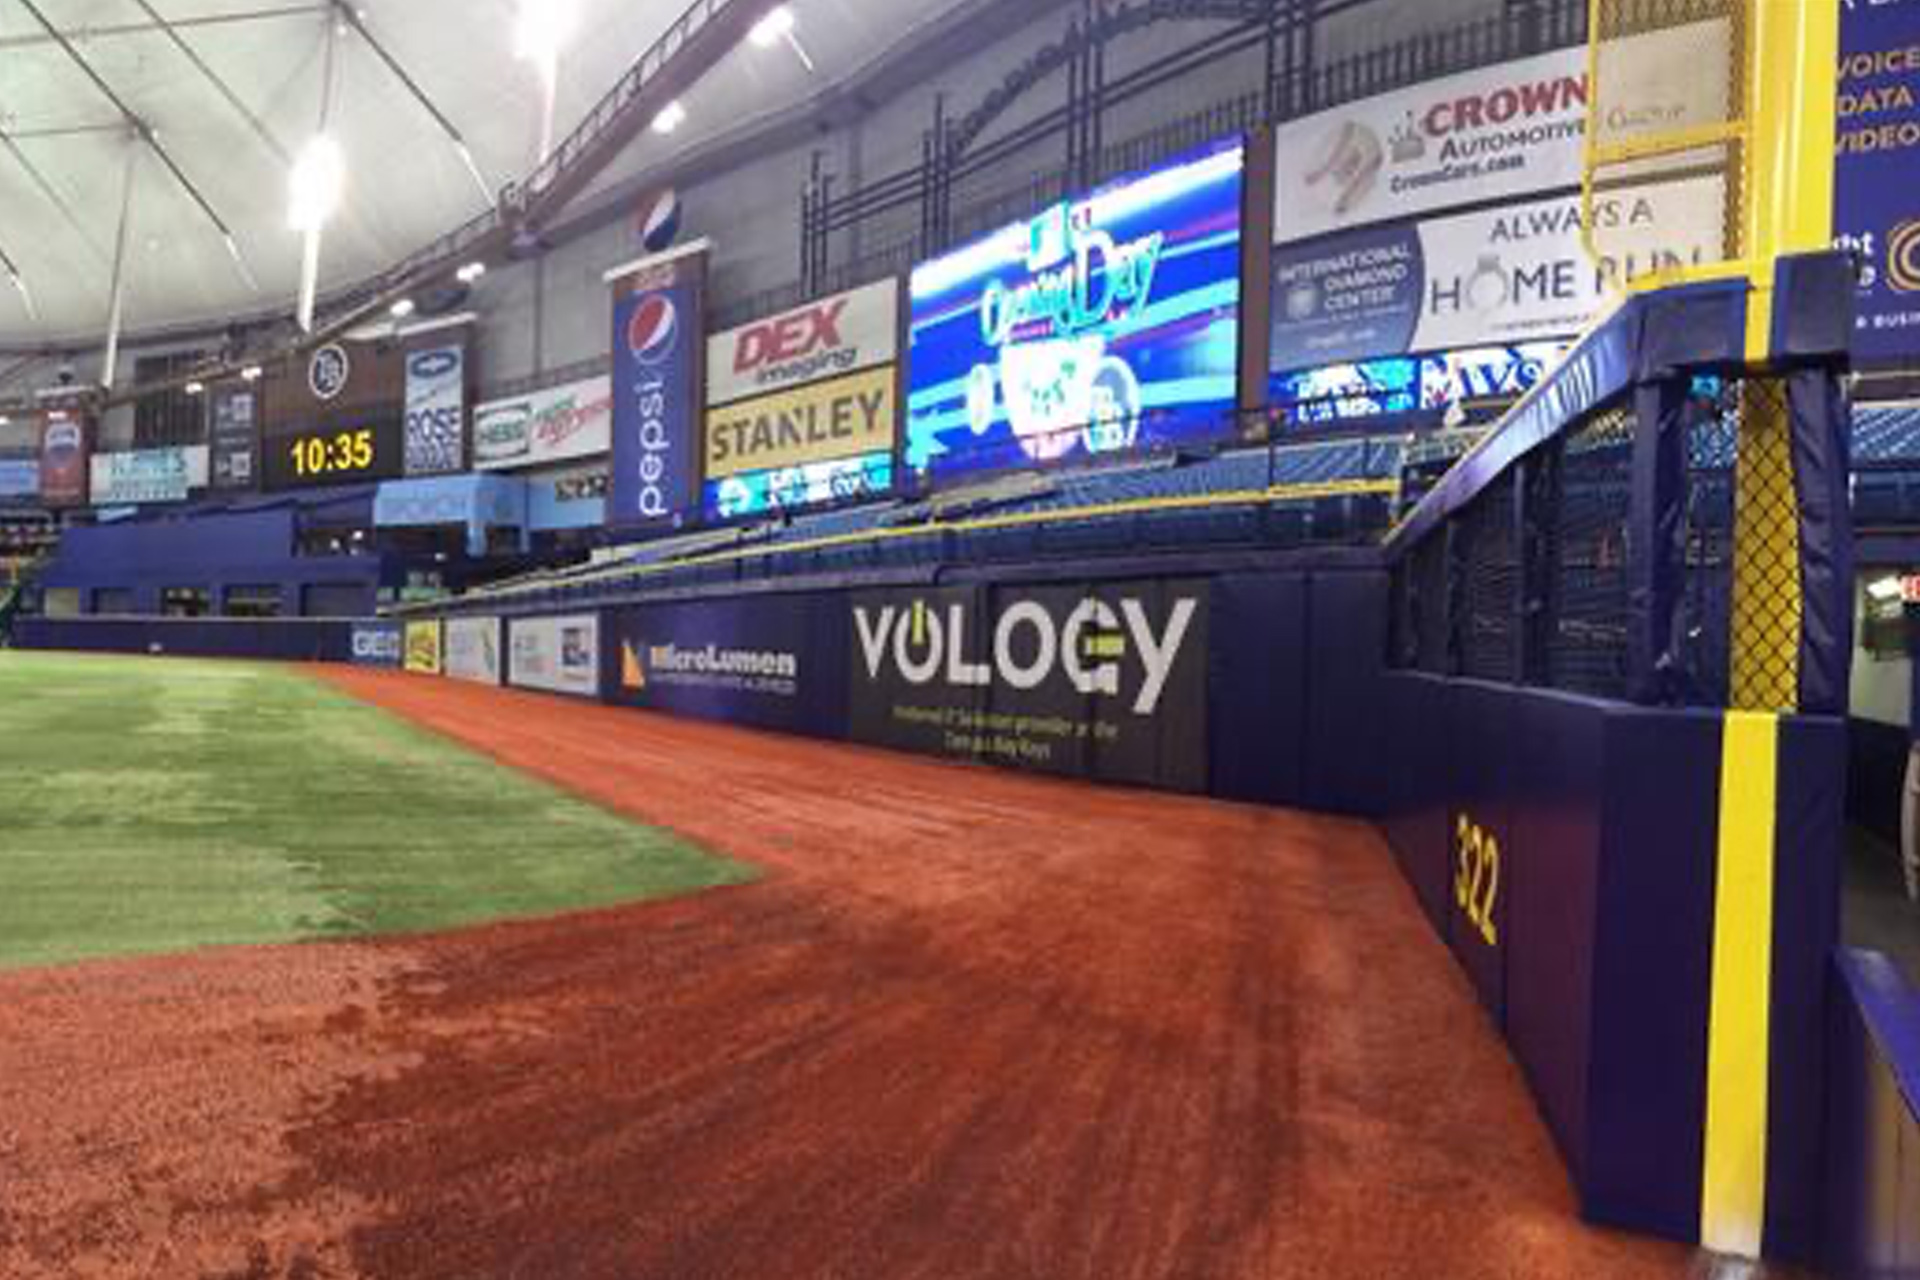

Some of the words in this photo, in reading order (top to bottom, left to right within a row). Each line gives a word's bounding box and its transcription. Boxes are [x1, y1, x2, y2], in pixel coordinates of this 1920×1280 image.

[1423, 73, 1588, 138] CROWN
[1836, 85, 1914, 117] DATA
[1629, 198, 1655, 225] A
[1324, 286, 1396, 311] CENTER
[732, 300, 846, 376] DEX
[290, 430, 373, 473] 10:35
[634, 379, 671, 517] pepsi
[710, 390, 886, 462] STANLEY
[853, 598, 1197, 714] VOLOGY
[1455, 813, 1500, 946] 322
